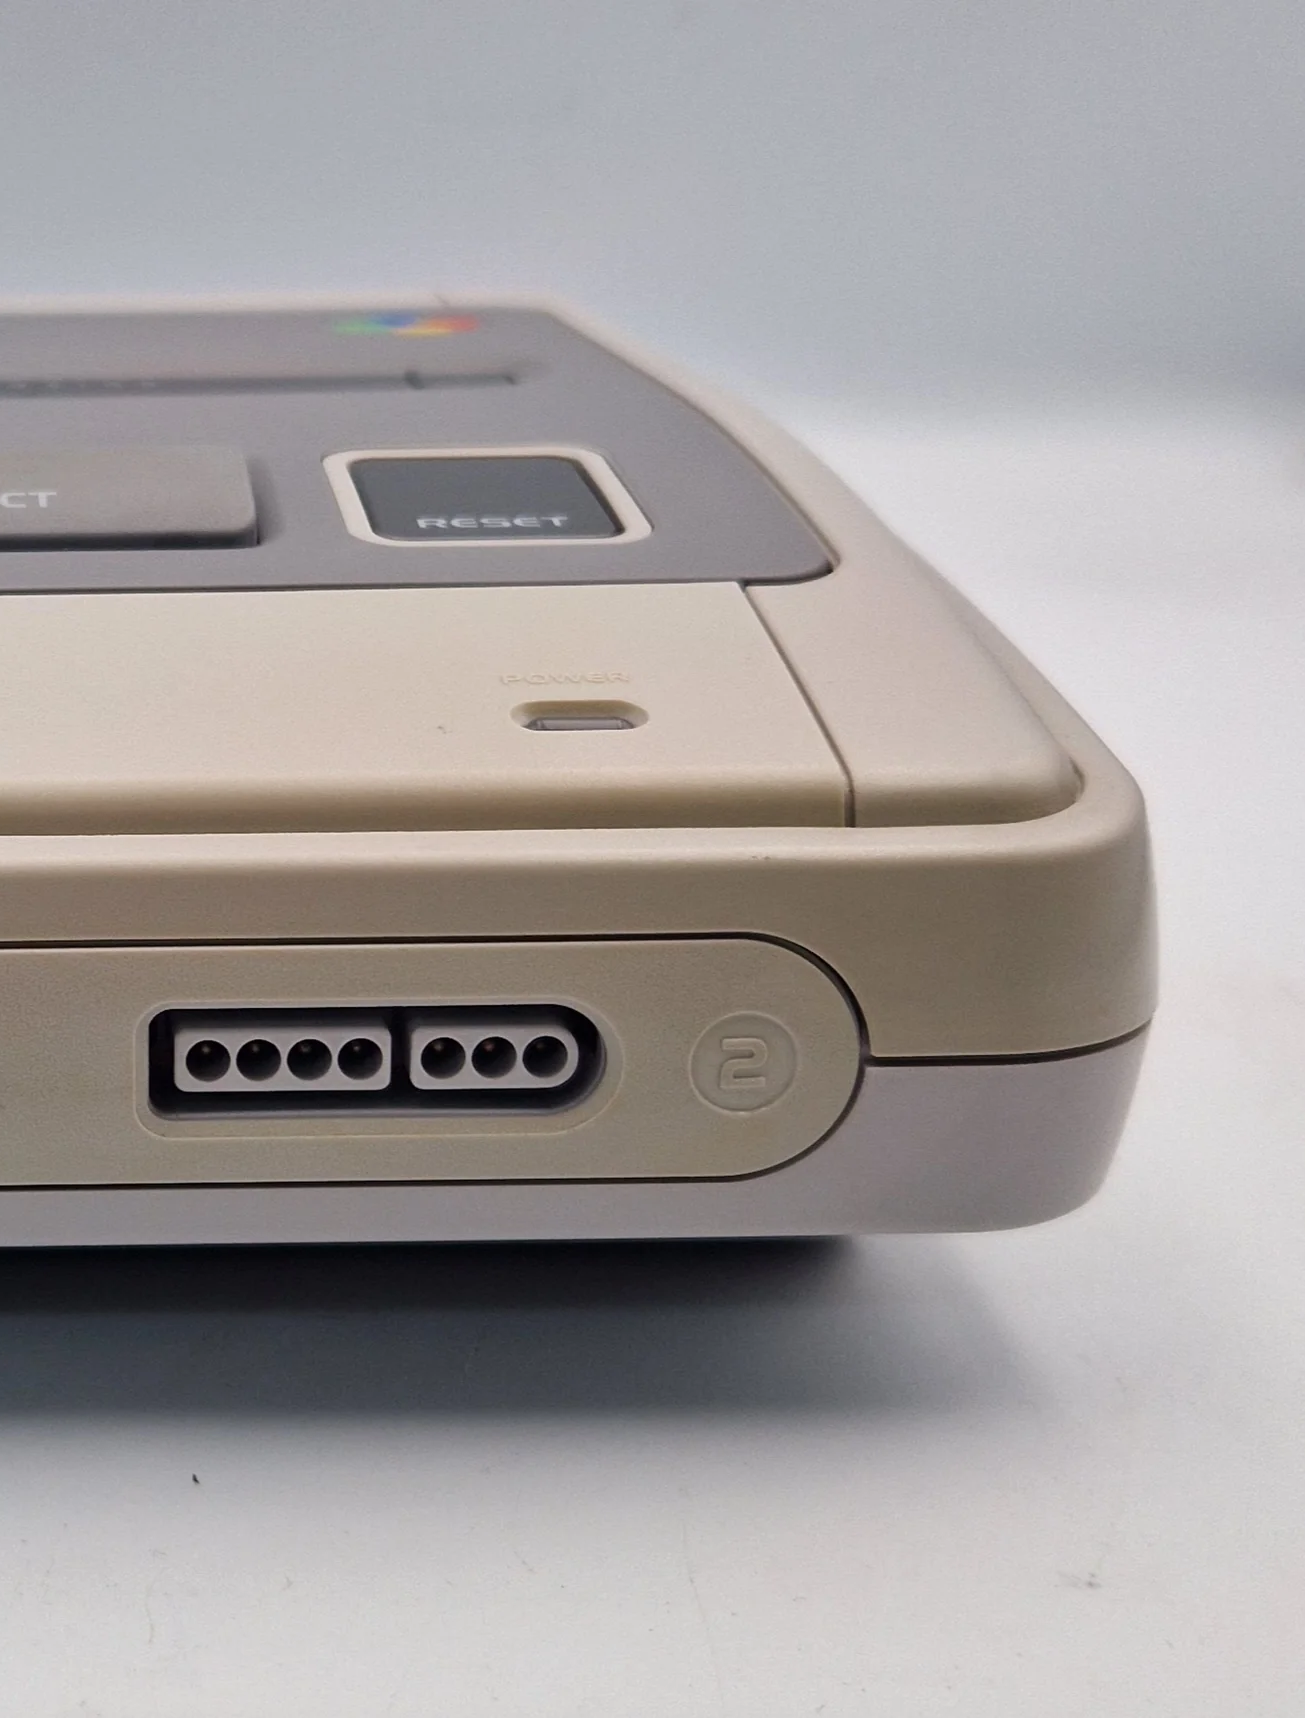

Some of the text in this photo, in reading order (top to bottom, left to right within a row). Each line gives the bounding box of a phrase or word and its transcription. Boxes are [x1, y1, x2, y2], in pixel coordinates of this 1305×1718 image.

[416, 516, 569, 529] RESET
[500, 671, 631, 685] POWER
[721, 1038, 768, 1089] 2
